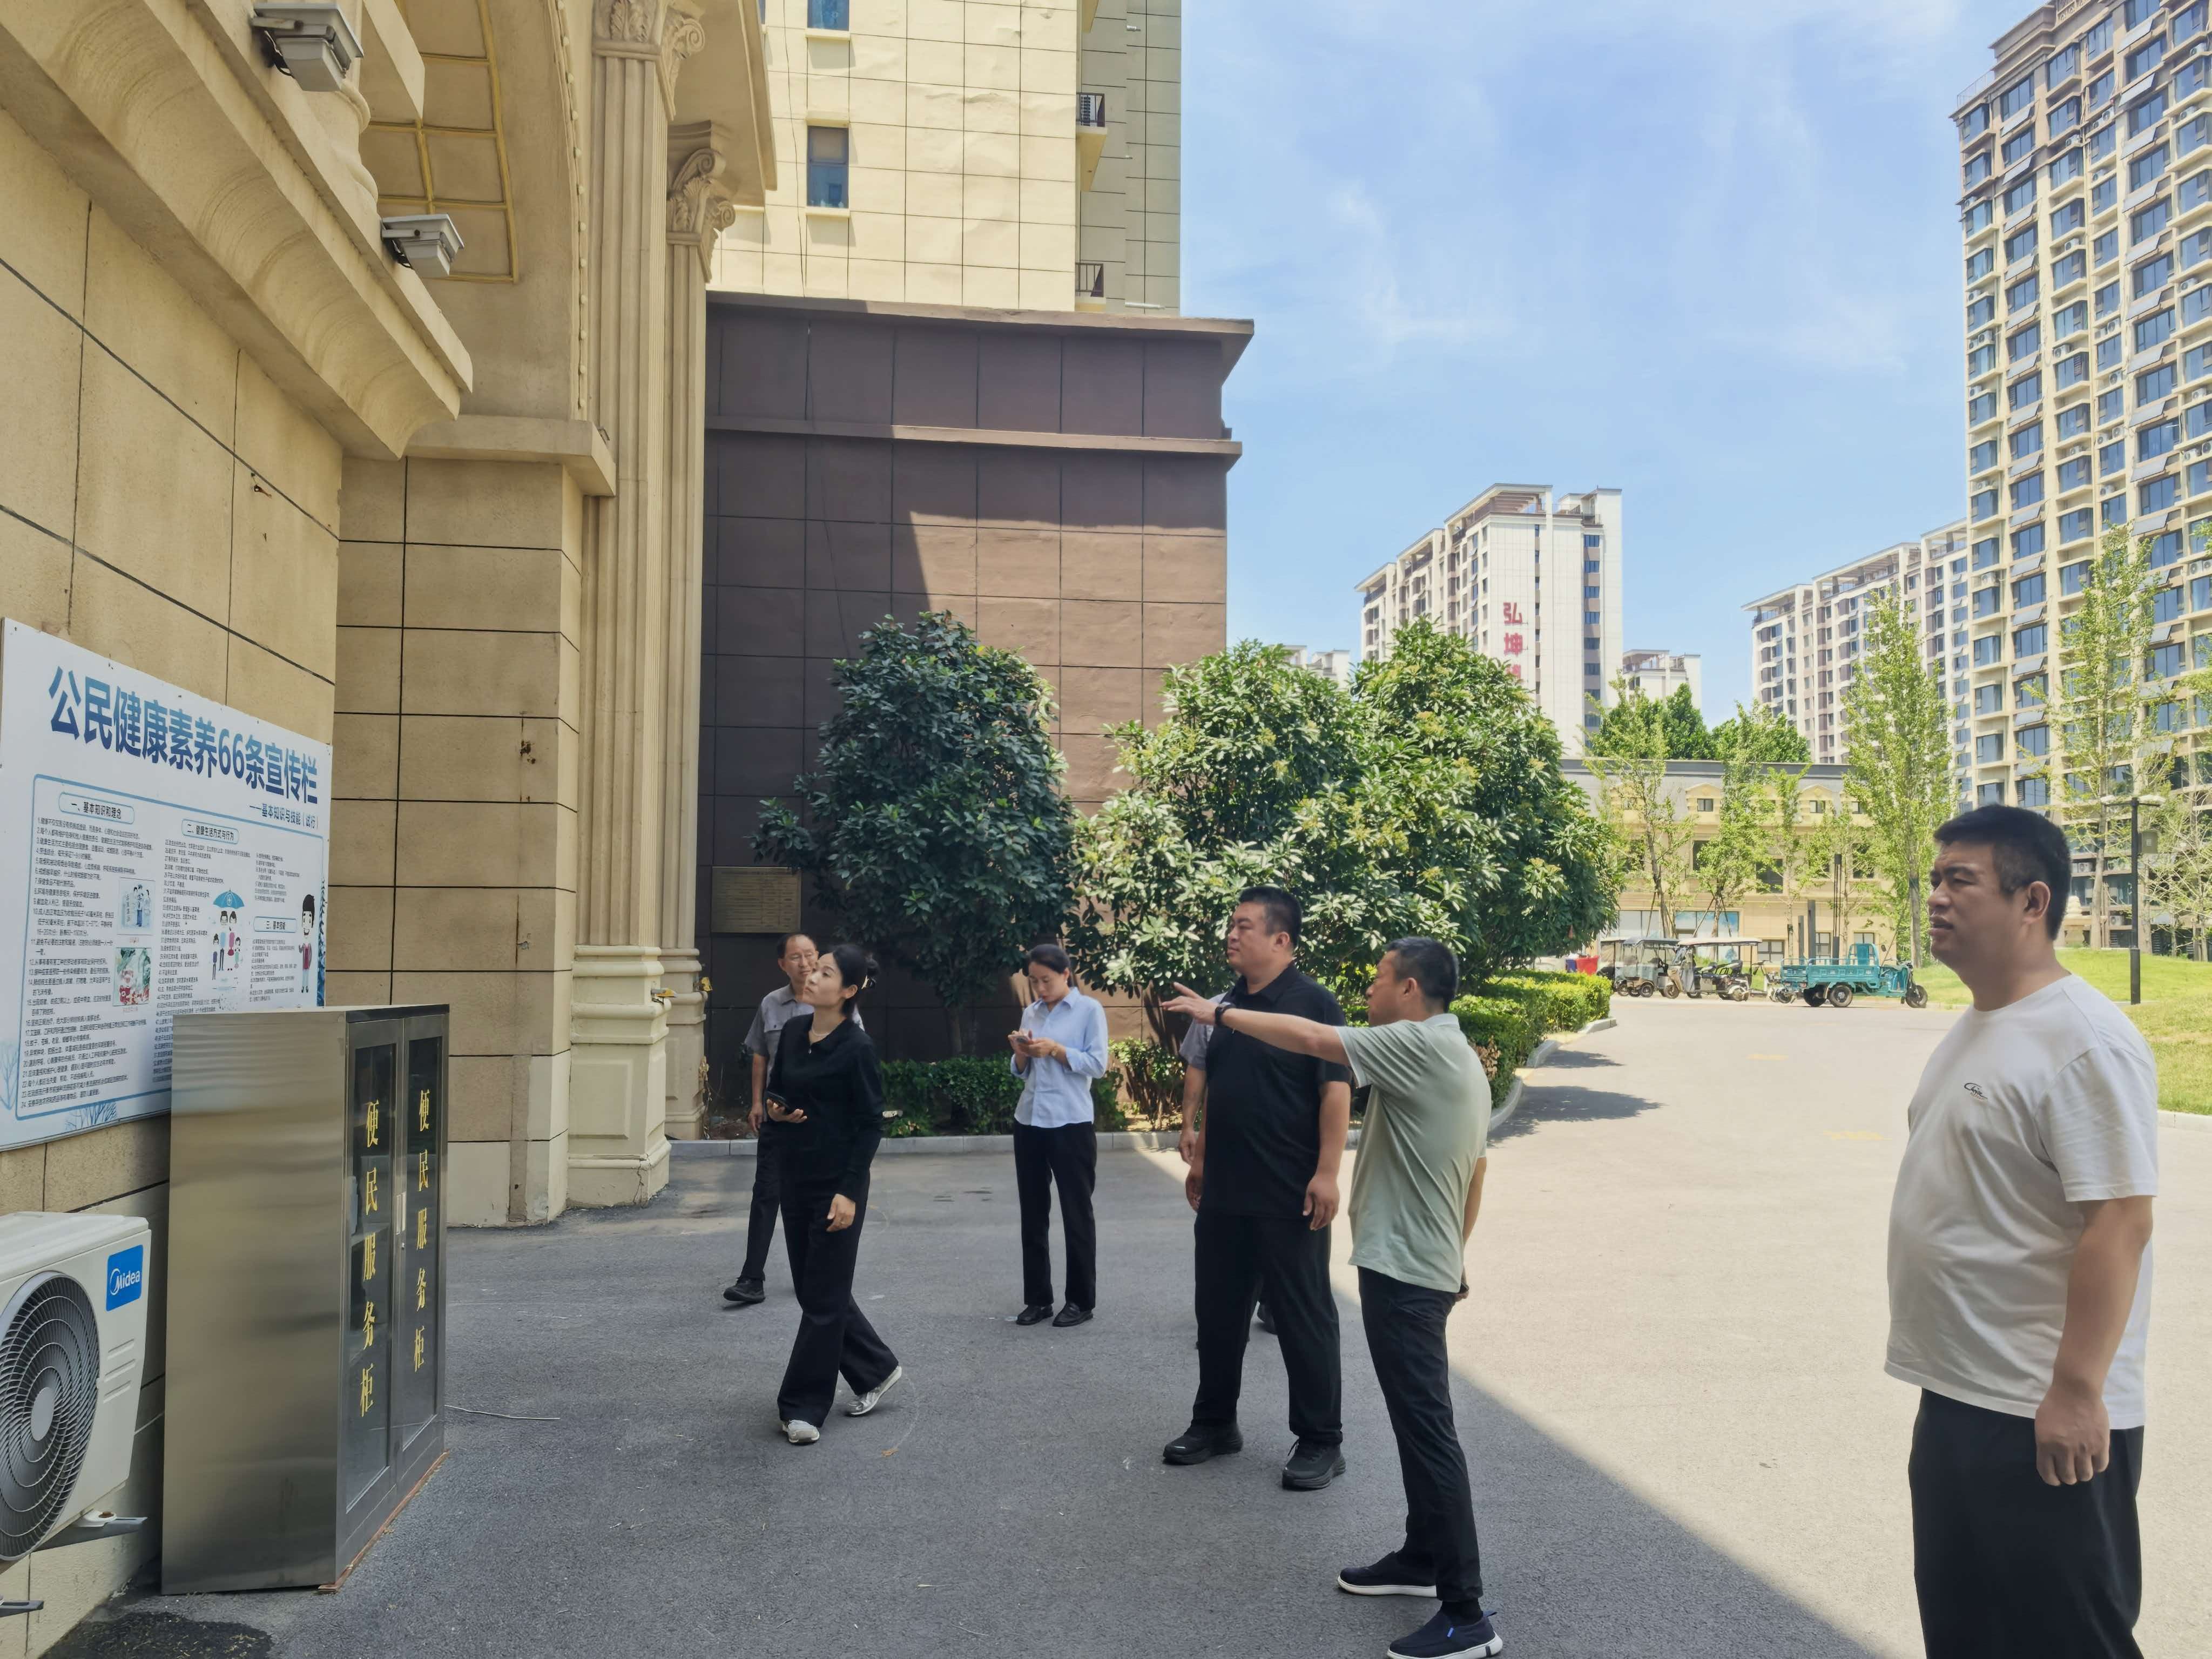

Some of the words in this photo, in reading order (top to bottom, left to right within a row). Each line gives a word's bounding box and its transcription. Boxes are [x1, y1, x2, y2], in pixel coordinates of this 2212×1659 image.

[49, 666, 318, 804] 公民健康素养66条宣传栏
[110, 1268, 140, 1295] Midea
[360, 1099, 379, 1417] 便民服务柜
[414, 1089, 430, 1372] 便民服务柜
